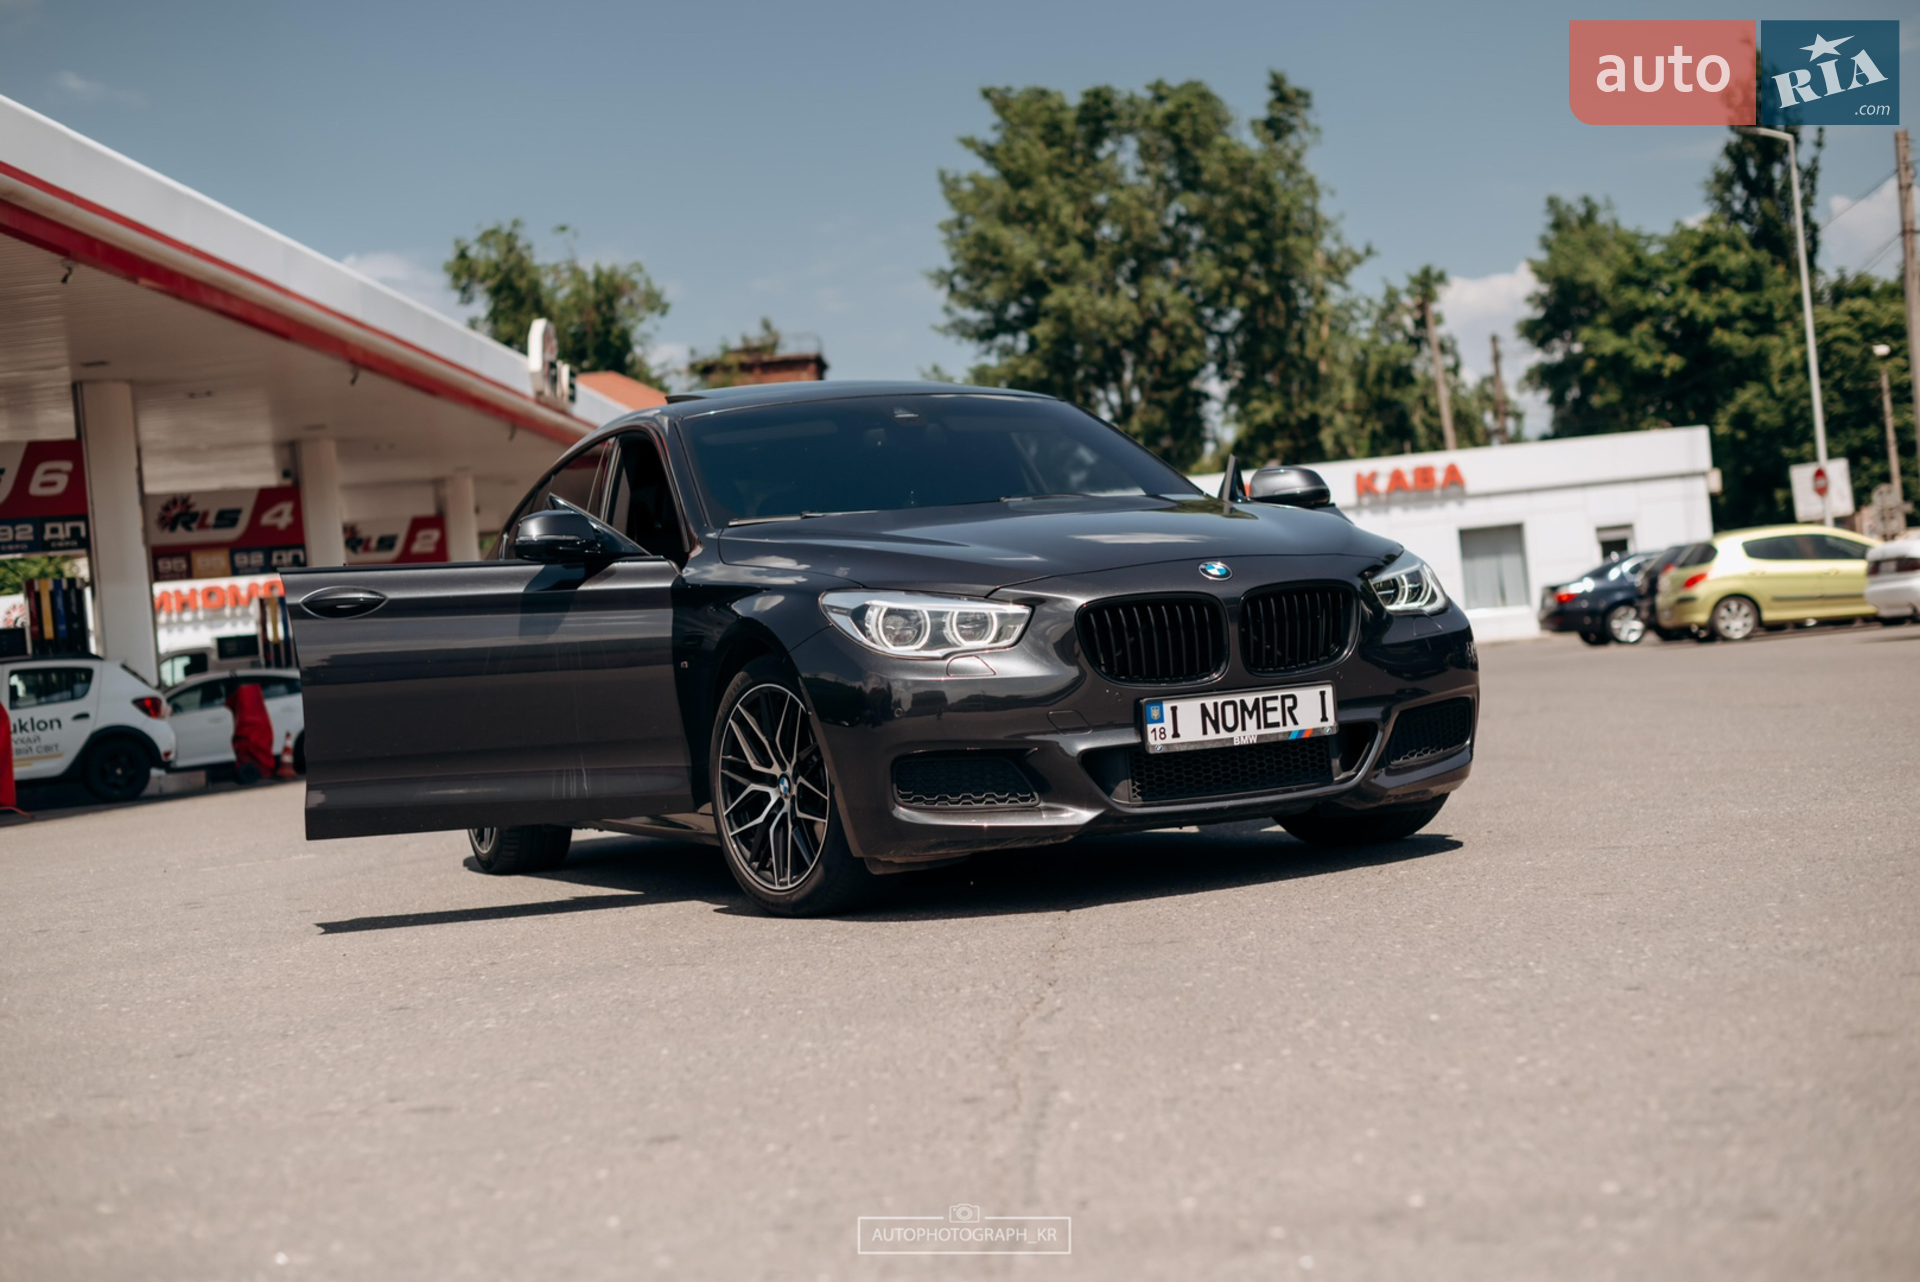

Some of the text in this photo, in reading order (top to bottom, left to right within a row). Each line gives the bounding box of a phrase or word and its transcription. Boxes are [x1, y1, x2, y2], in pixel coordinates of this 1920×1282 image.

[28, 461, 74, 496] 6
[1355, 463, 1465, 495] КАВА
[168, 501, 294, 532] RLS 4
[0, 521, 86, 541] 92 ДП
[410, 529, 441, 554] 2
[1201, 693, 1299, 736] NOMER
[1150, 726, 1167, 741] 18
[1233, 735, 1258, 745] BMW
